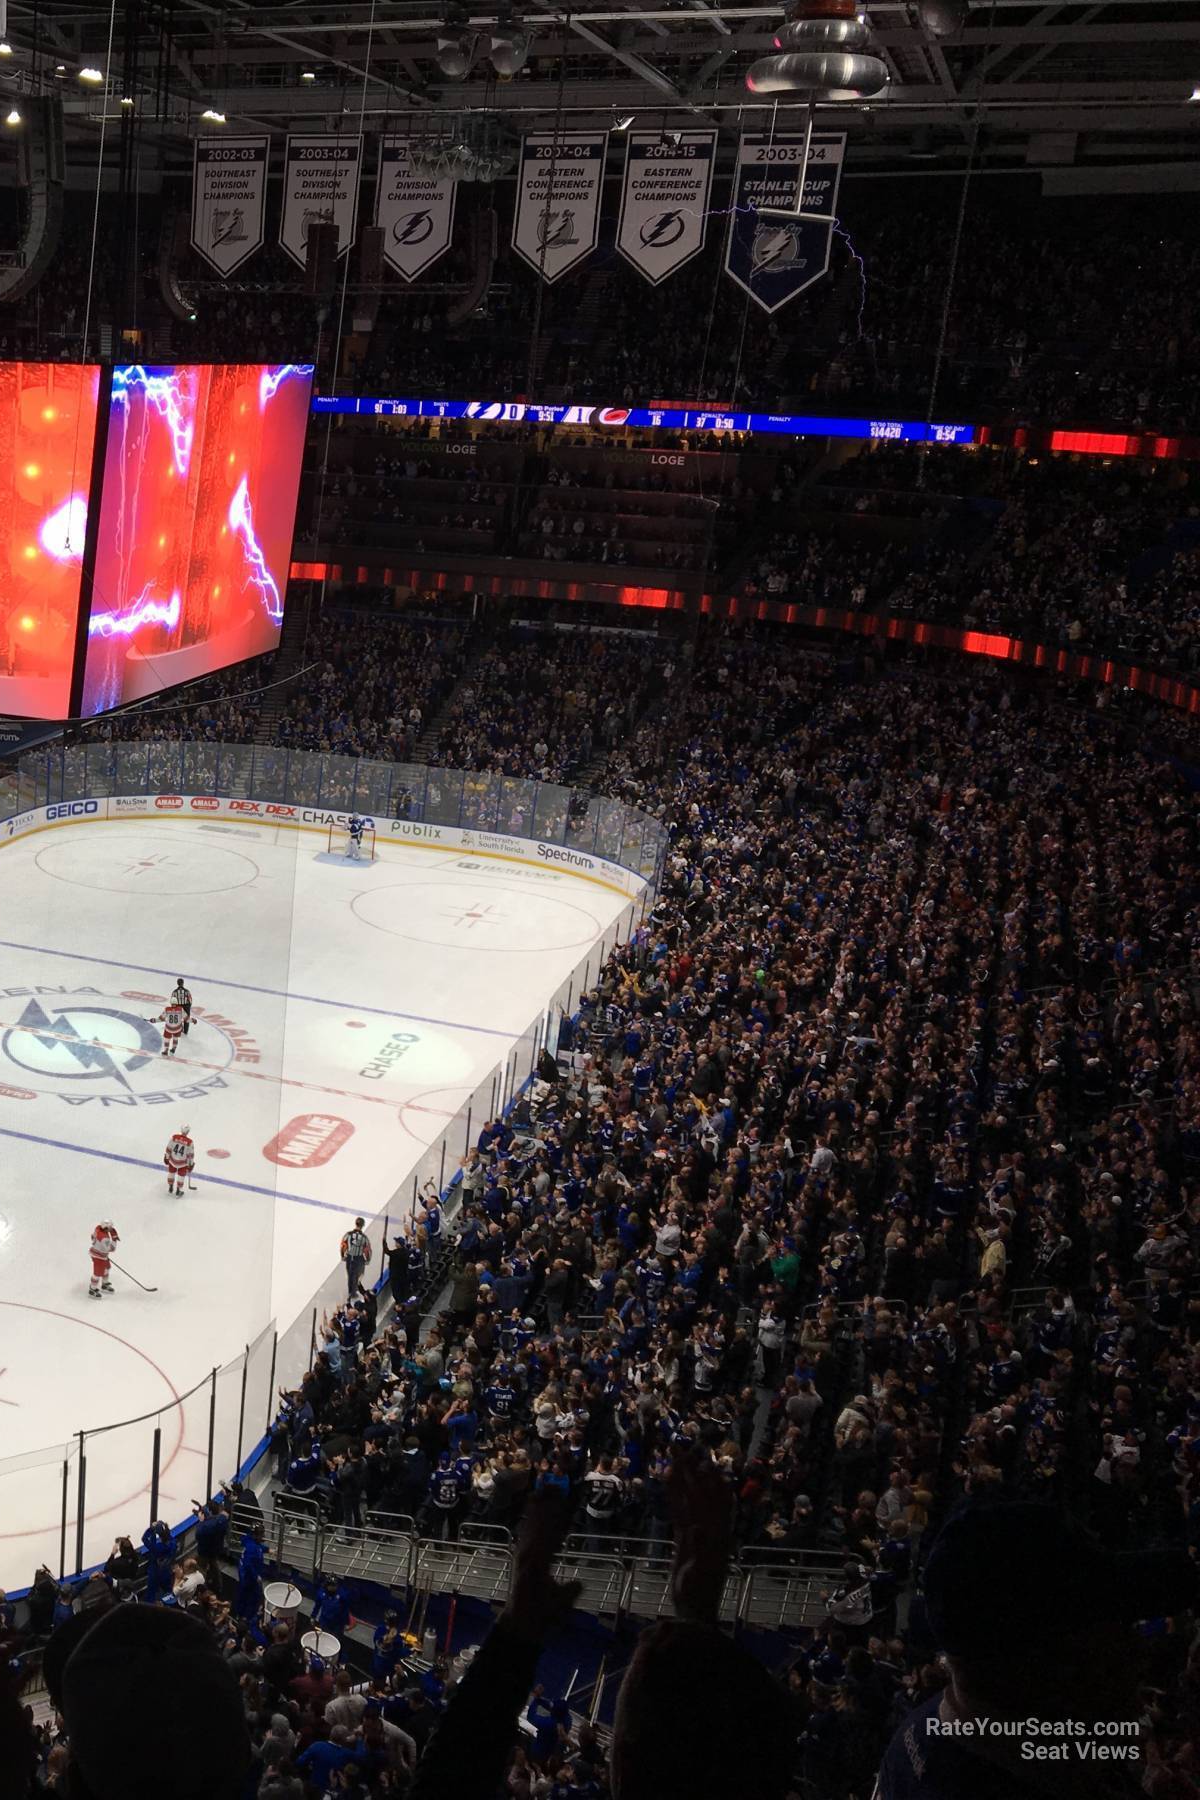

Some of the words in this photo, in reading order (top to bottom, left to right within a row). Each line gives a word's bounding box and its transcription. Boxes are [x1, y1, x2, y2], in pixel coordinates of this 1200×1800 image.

[207, 149, 256, 160] 2002-03
[299, 149, 349, 160] 2003-04
[645, 145, 697, 157] 2014-15
[205, 169, 257, 178] SOUTHEAST
[296, 169, 350, 178] SOUTHEAST
[538, 168, 585, 177] EASTERN
[643, 168, 693, 177] EASTERN
[211, 181, 249, 189] DIVISION
[302, 181, 341, 189] DIVISION
[395, 181, 438, 190] DIVISION
[631, 180, 703, 189] CONFERENCE
[743, 180, 798, 191] STANLEY
[803, 180, 831, 191] CUP
[203, 192, 256, 200] CHAMPIONS
[294, 191, 348, 200] CHAMPIONS
[387, 192, 445, 201] CHAMPIONS
[529, 191, 589, 201] CHAMPIONS
[634, 192, 697, 201] CHAMPIONS
[374, 404, 383, 413] 91
[392, 404, 408, 415] 1:03
[439, 406, 445, 416] 9
[509, 405, 518, 419] 0
[538, 411, 555, 421] 9:51
[651, 416, 662, 427] 16
[696, 417, 705, 428] 37
[715, 417, 734, 429] 0:50
[936, 429, 956, 441] 8:54
[446, 443, 478, 455] LOGE
[651, 454, 686, 466] LOGE
[46, 800, 98, 821] GEICO
[228, 800, 262, 812] DEX
[265, 805, 297, 816] DEX
[391, 820, 441, 839] Publix
[479, 841, 498, 850] South
[537, 843, 593, 869] Spectrum
[168, 1014, 179, 1025] 86
[191, 1006, 262, 1065] AMALIE
[358, 1041, 410, 1080] CHASE
[56, 1075, 230, 1108] ARENA
[276, 1115, 343, 1167] AMALIE
[173, 1143, 185, 1158] 44
